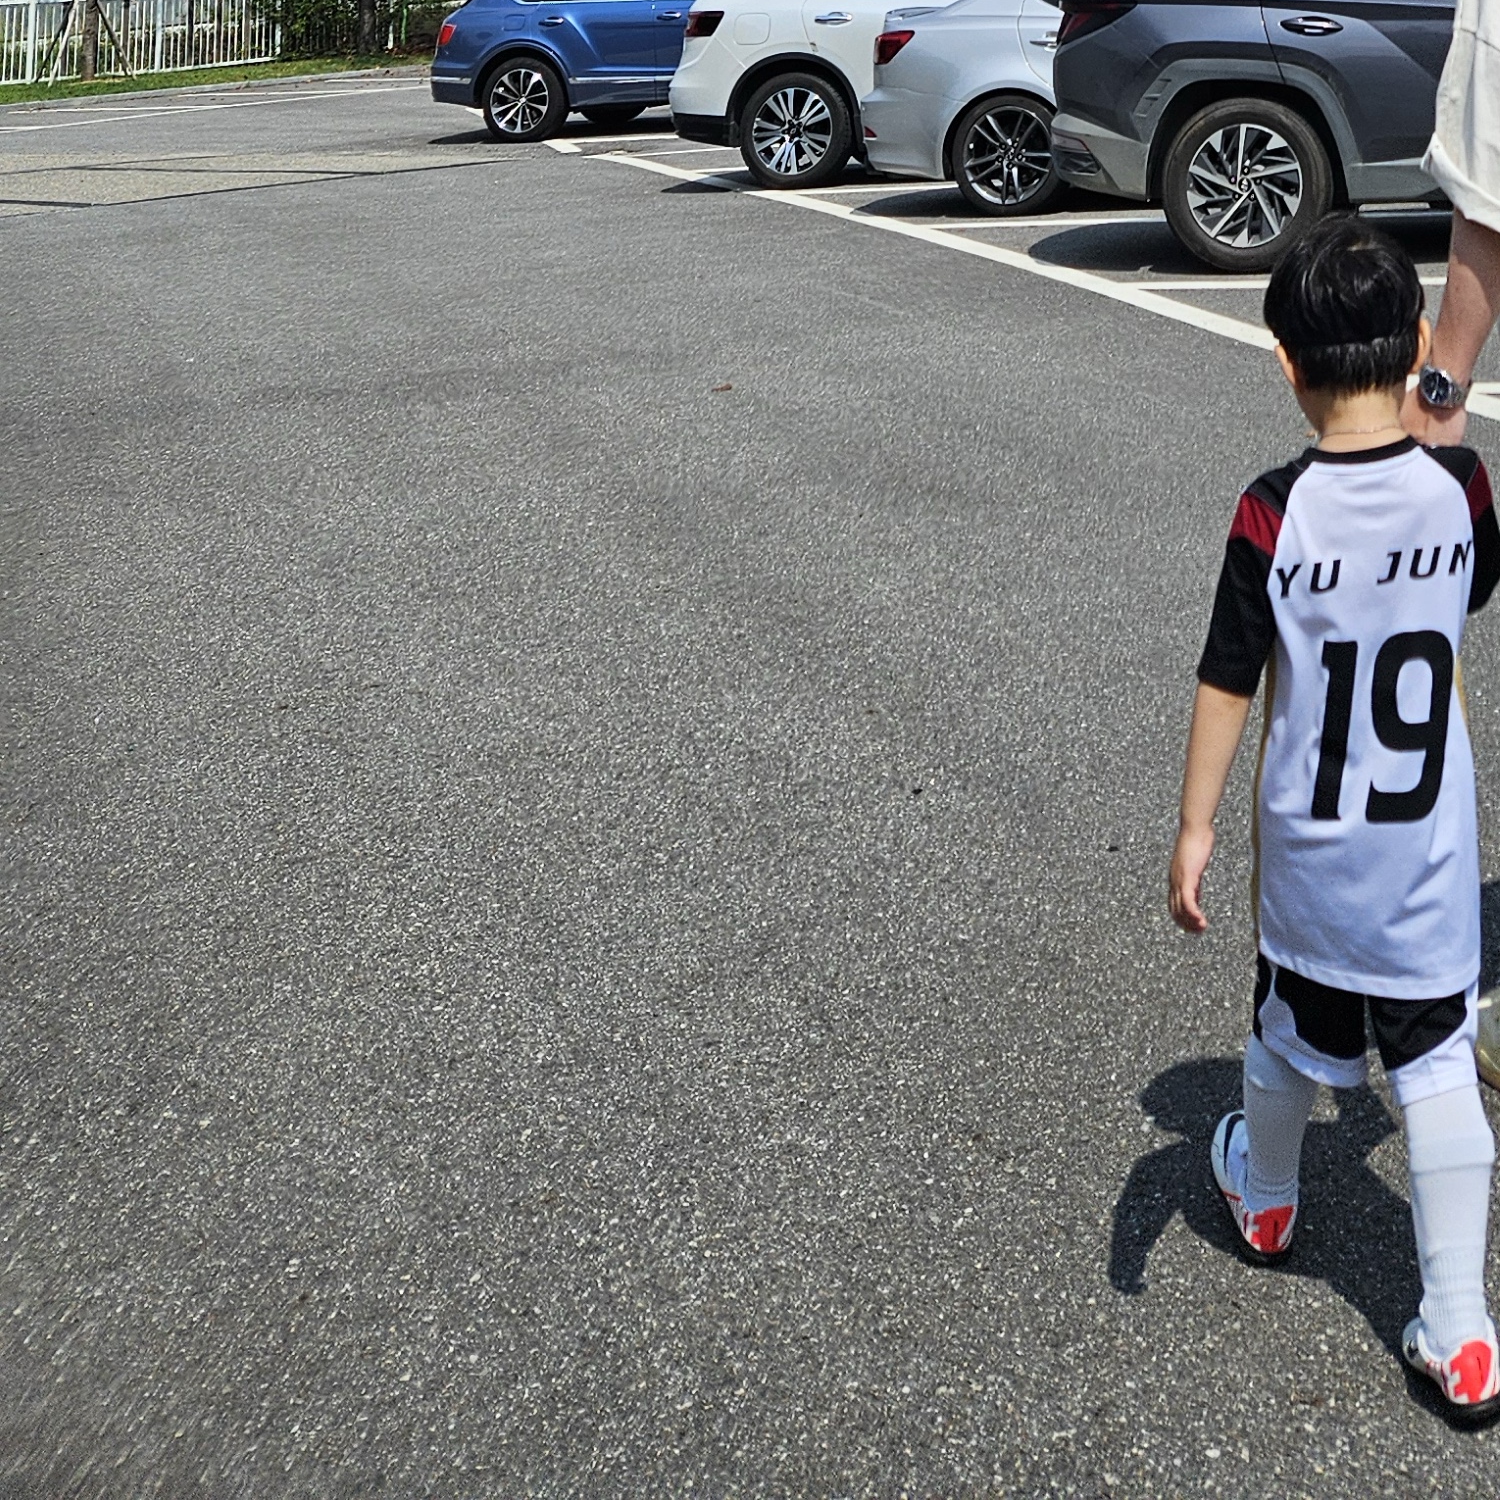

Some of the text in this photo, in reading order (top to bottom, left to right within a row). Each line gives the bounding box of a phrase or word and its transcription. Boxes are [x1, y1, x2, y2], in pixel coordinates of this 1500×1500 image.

[1275, 540, 1473, 599] YU JUN
[1310, 629, 1454, 824] 19
